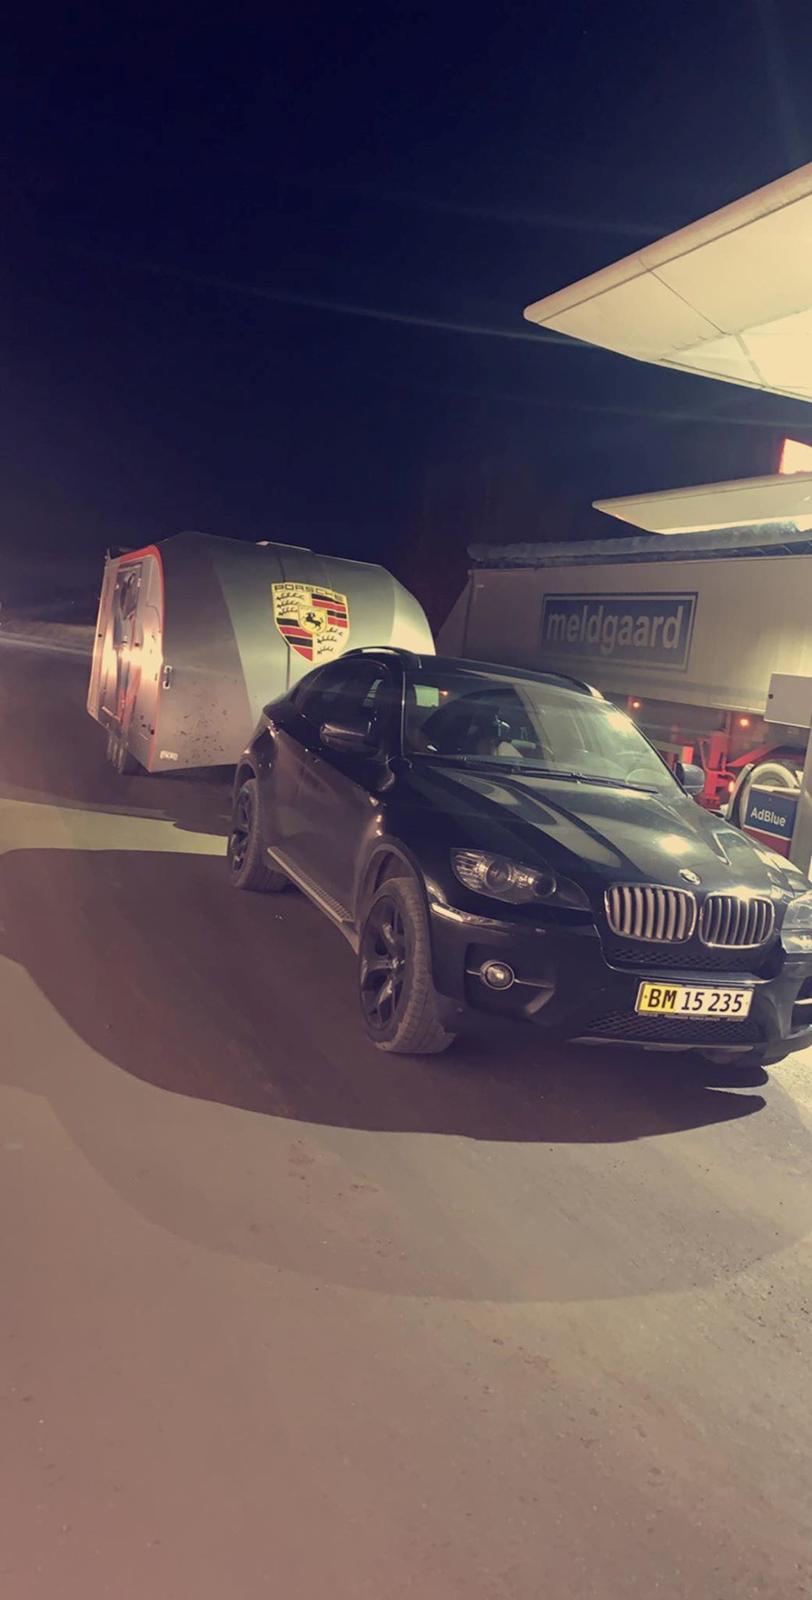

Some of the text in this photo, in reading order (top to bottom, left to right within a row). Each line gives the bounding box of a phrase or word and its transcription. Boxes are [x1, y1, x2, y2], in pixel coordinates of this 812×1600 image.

[274, 584, 343, 601] PORSCHE
[547, 605, 683, 655] meldgaard
[751, 807, 786, 827] AdBlue
[647, 988, 744, 1012] BM 15 235
